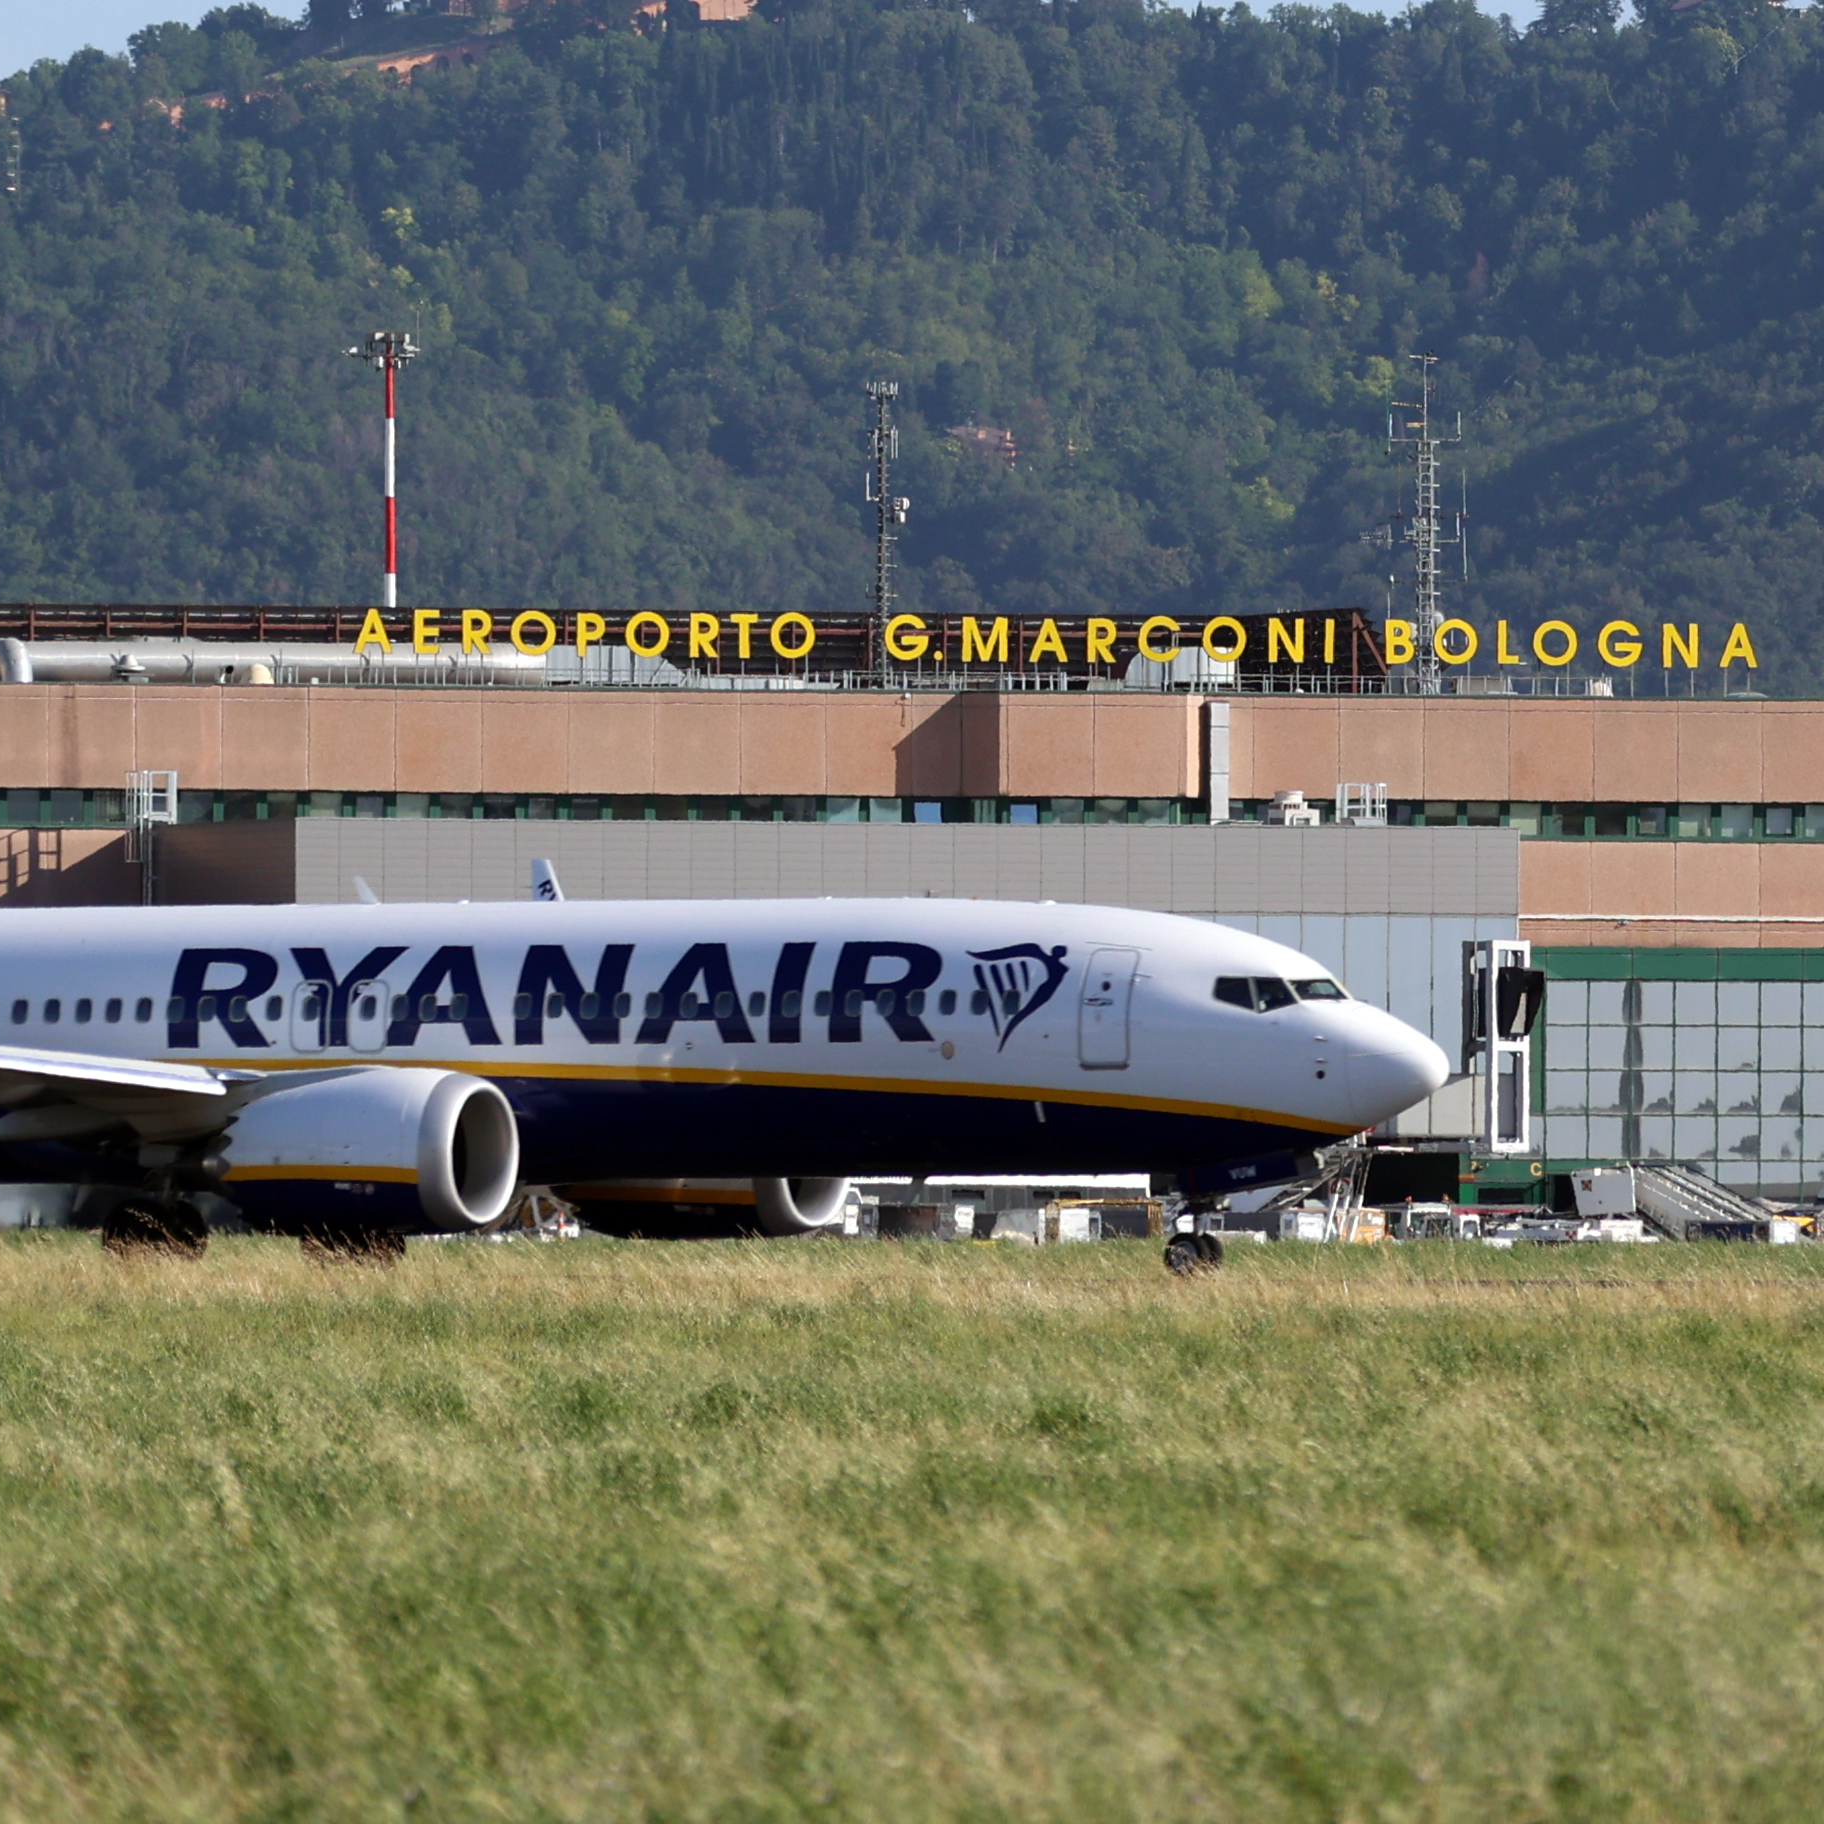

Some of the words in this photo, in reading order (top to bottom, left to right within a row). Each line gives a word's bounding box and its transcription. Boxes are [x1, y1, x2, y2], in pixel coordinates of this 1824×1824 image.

[356, 609, 816, 659] AEROPORTO
[884, 613, 1335, 662] G.MARCONI
[1385, 619, 1758, 667] BOLOGNA
[166, 940, 943, 1049] RYANAIR
[1529, 1161, 1543, 1177] C
